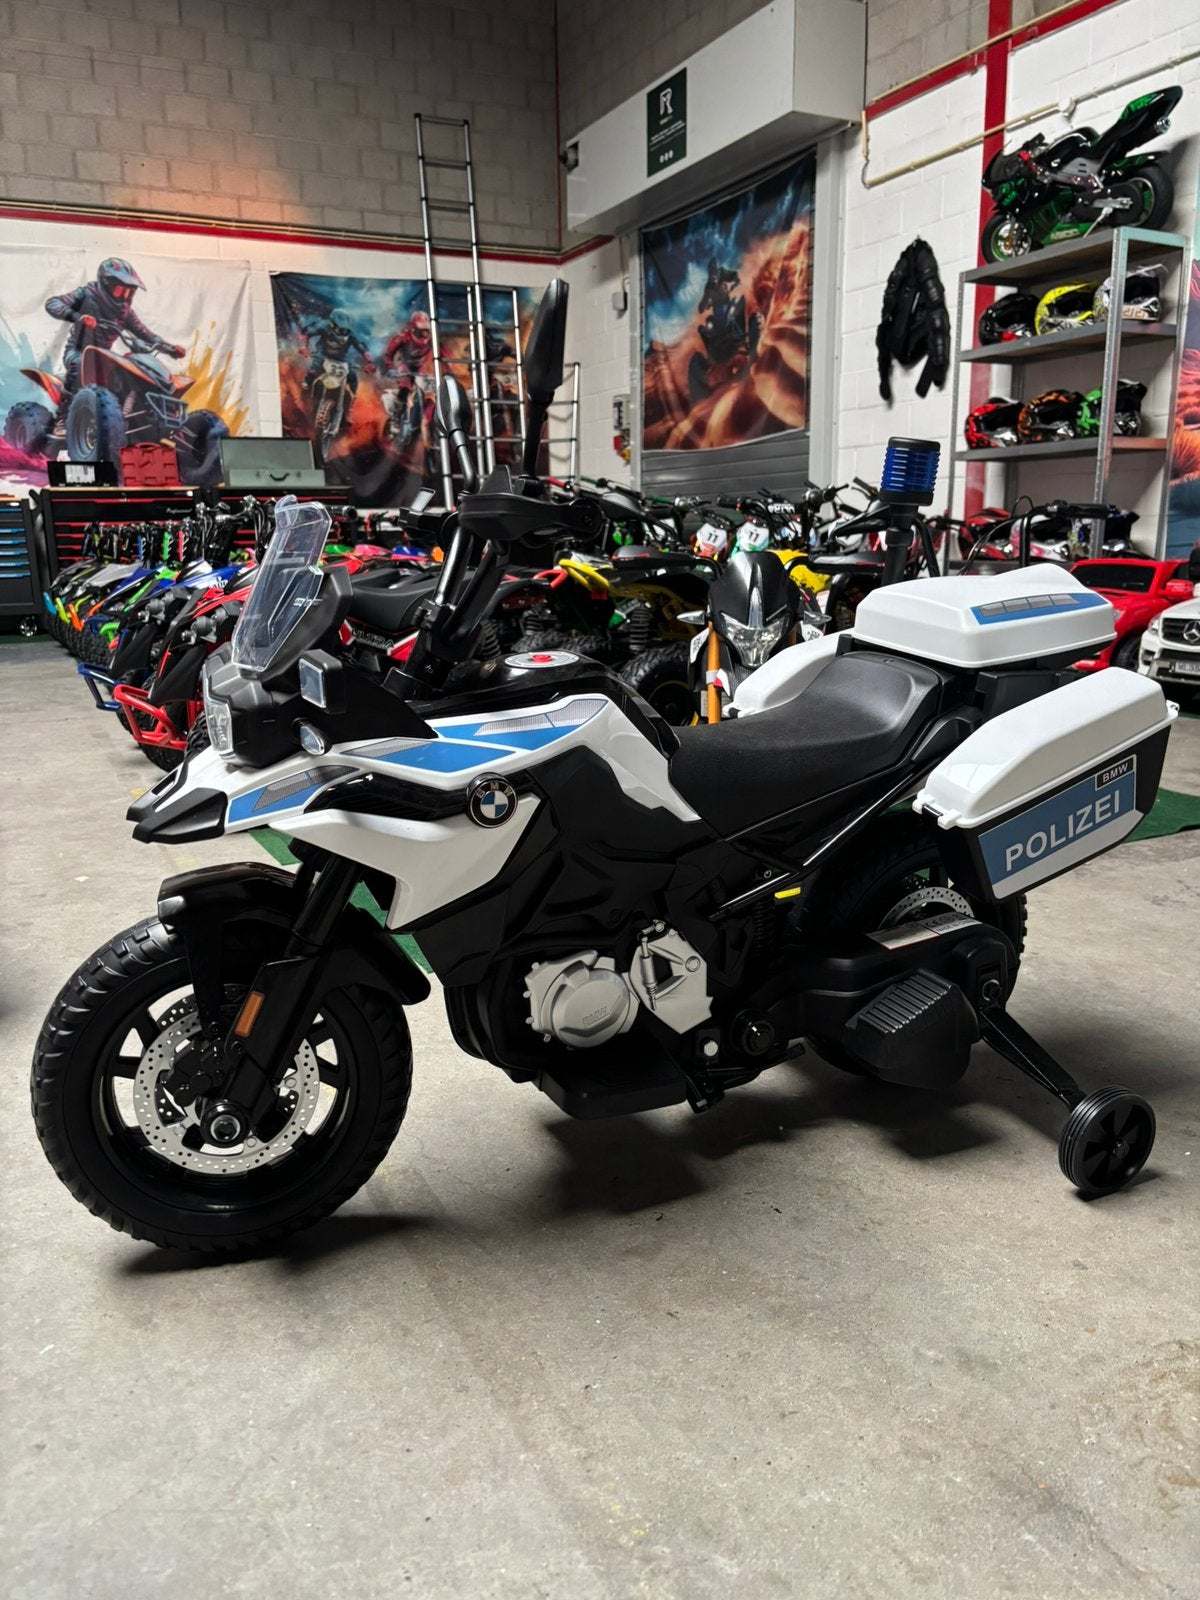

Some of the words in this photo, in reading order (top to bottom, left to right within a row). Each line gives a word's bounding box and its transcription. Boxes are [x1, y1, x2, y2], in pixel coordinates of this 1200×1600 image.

[1102, 762, 1129, 784] BMW
[475, 782, 514, 798] BMW
[1005, 789, 1120, 872] POLIZEI
